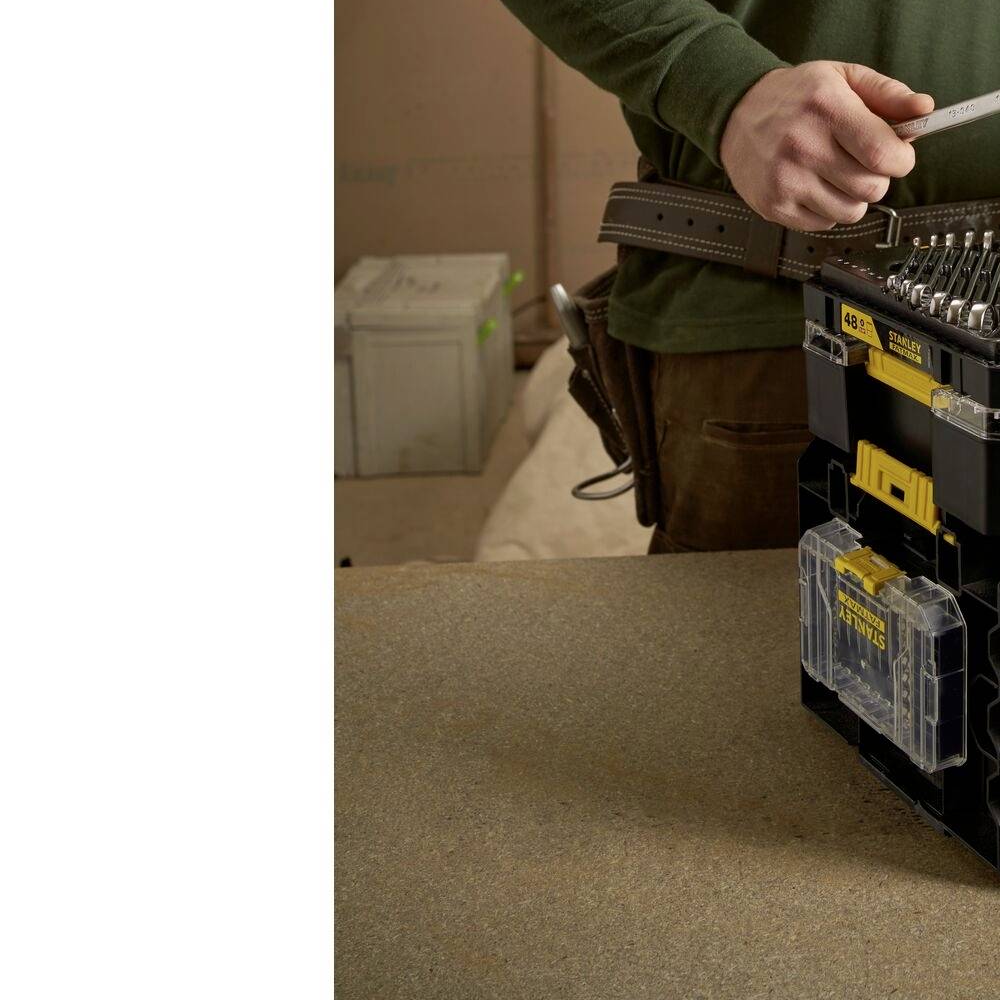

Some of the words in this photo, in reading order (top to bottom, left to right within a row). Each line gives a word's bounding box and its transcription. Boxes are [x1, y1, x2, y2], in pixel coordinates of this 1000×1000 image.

[844, 312, 858, 330] 48
[888, 330, 922, 354] STANLEY
[839, 605, 886, 650] STANLEY
